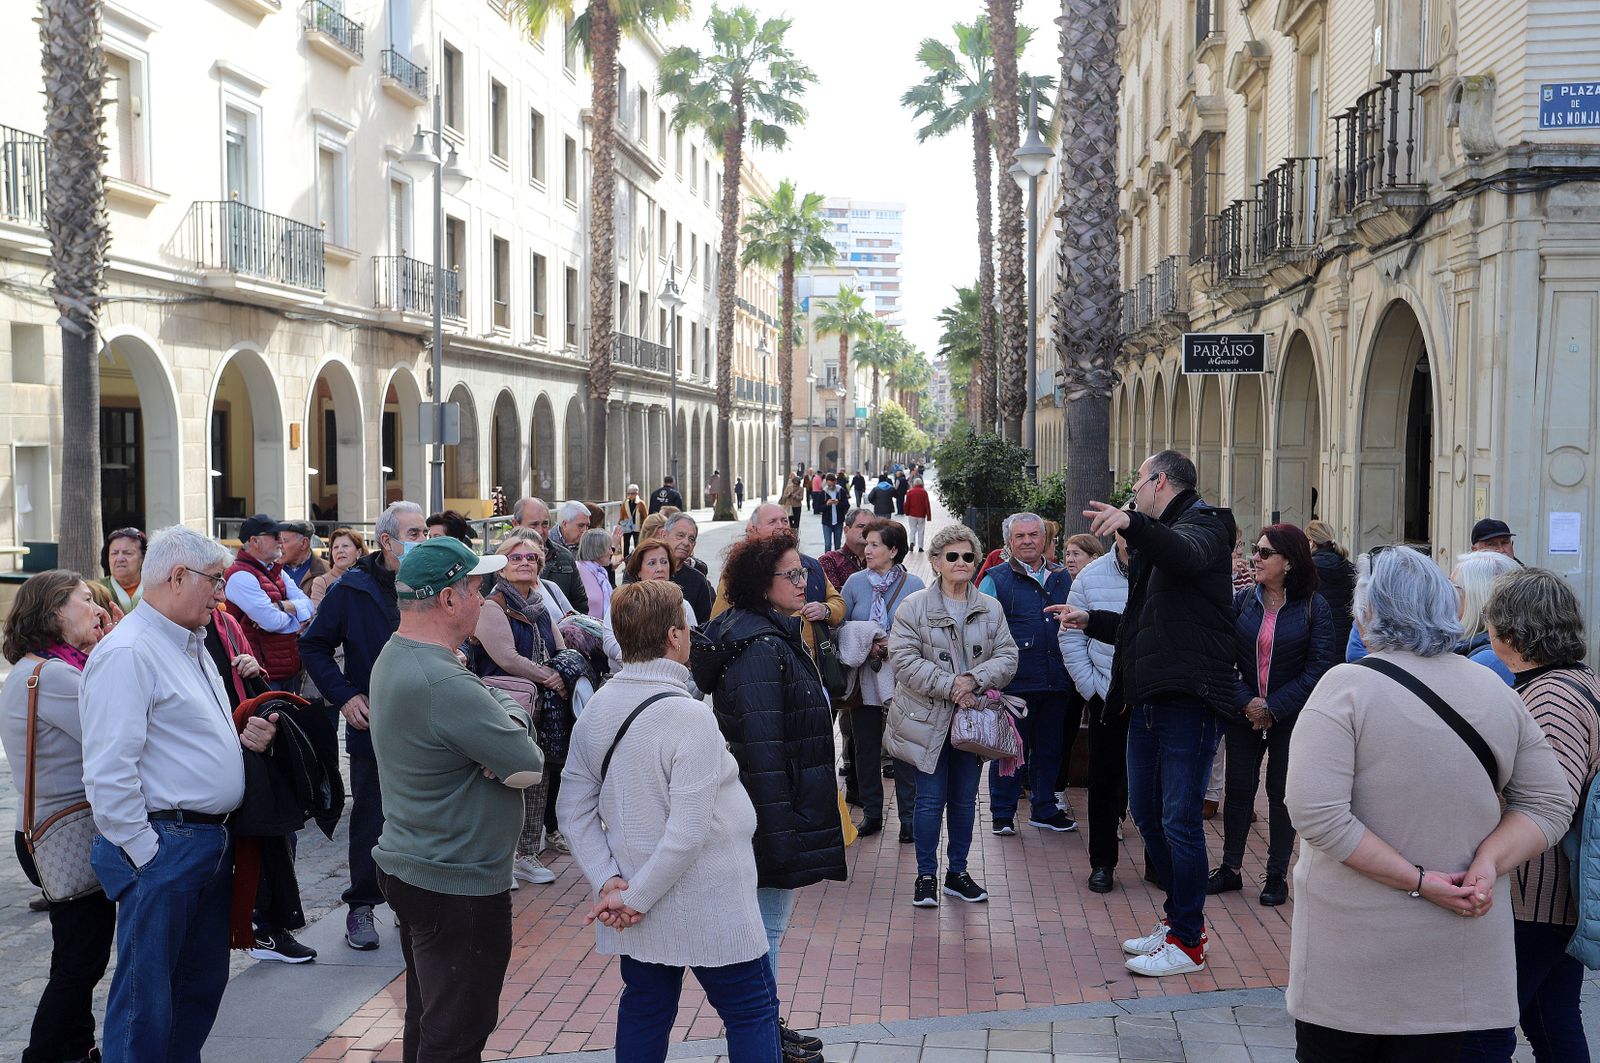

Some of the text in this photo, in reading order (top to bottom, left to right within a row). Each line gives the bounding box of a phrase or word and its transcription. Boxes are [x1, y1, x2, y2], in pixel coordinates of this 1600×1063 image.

[1561, 86, 1600, 96] PLAZA
[1571, 99, 1580, 108] DE
[1543, 112, 1563, 126] LAS
[1220, 336, 1228, 345] El
